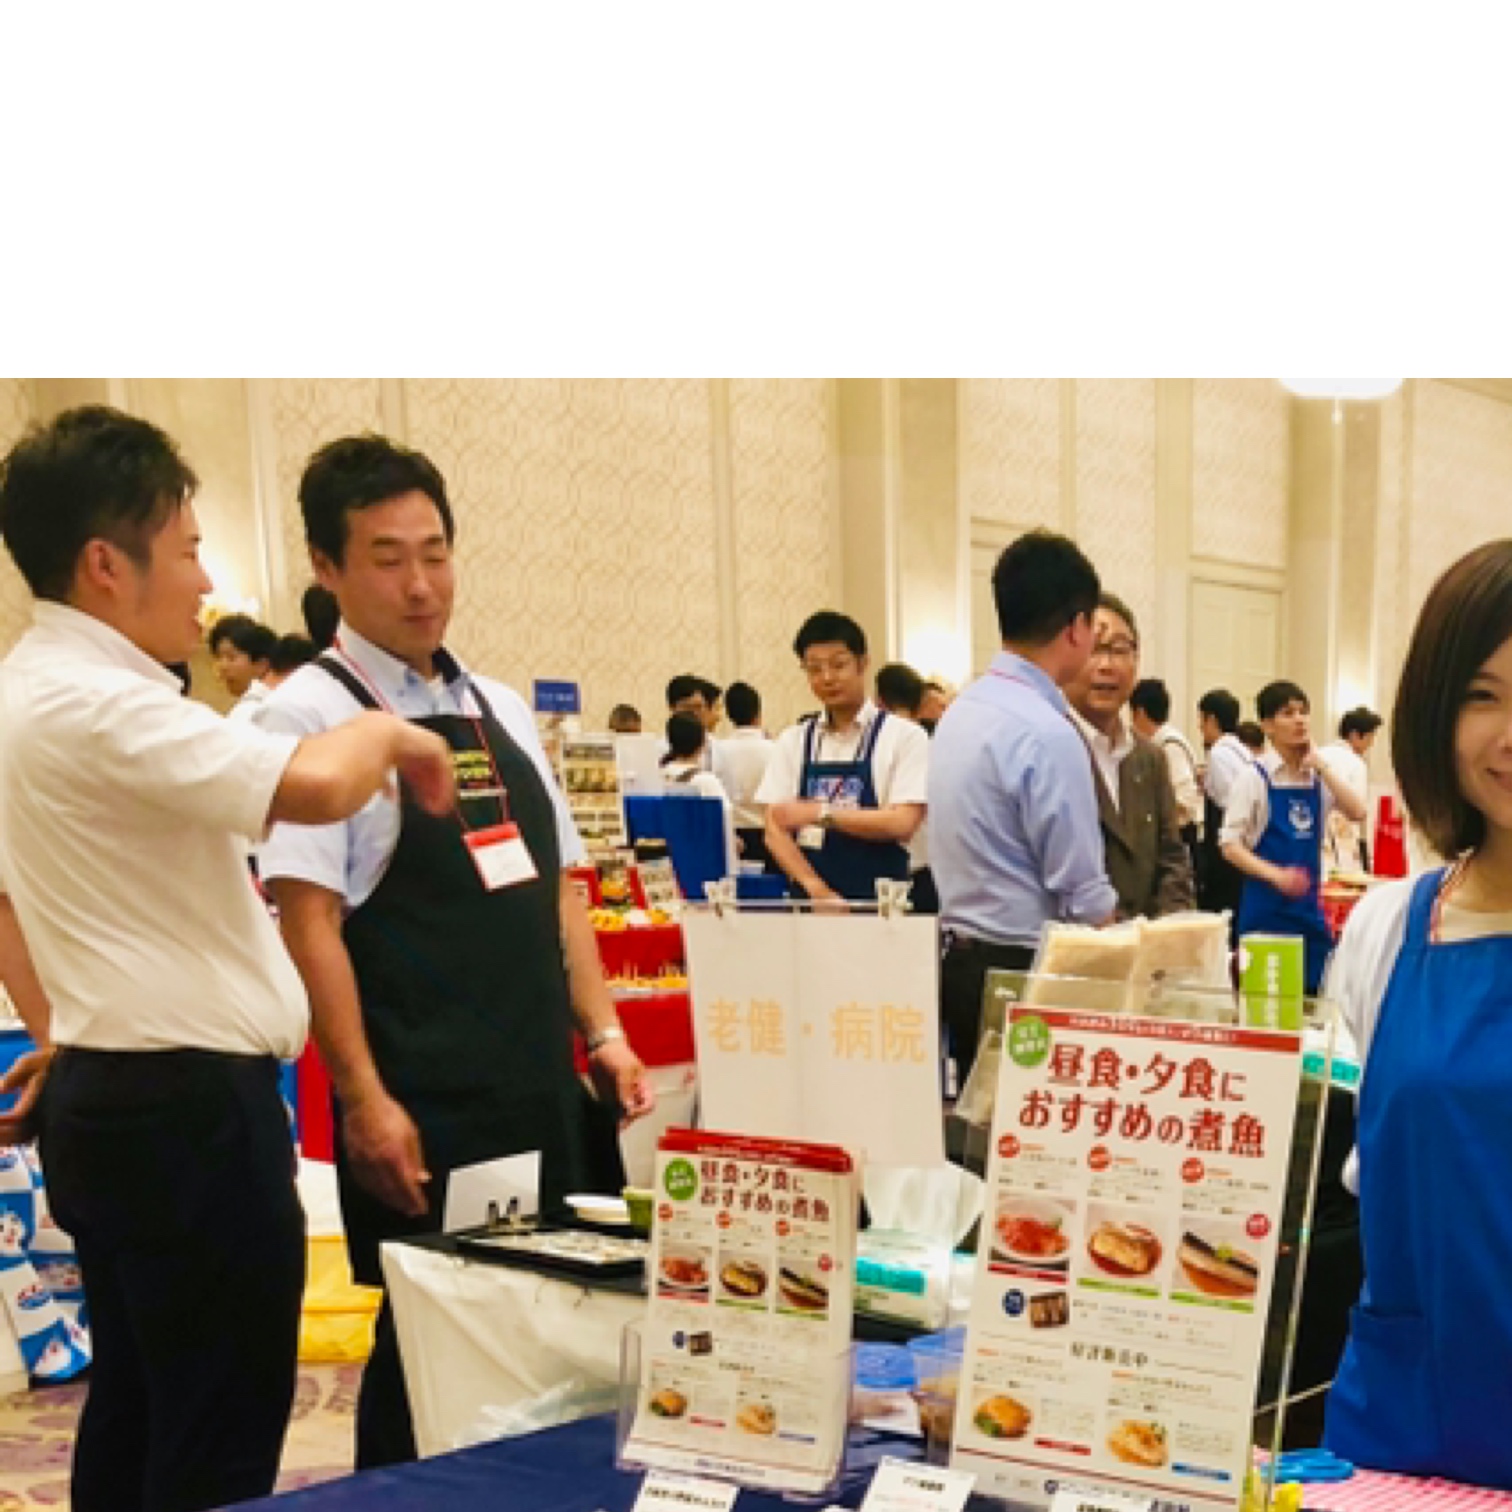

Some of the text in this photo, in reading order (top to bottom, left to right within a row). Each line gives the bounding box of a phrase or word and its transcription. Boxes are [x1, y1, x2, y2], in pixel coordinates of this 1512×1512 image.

[704, 998, 928, 1066] 老健・病院
[1047, 1042, 1247, 1103] 昼食・夕食に
[1018, 1090, 1267, 1159] おすすめの煮魚
